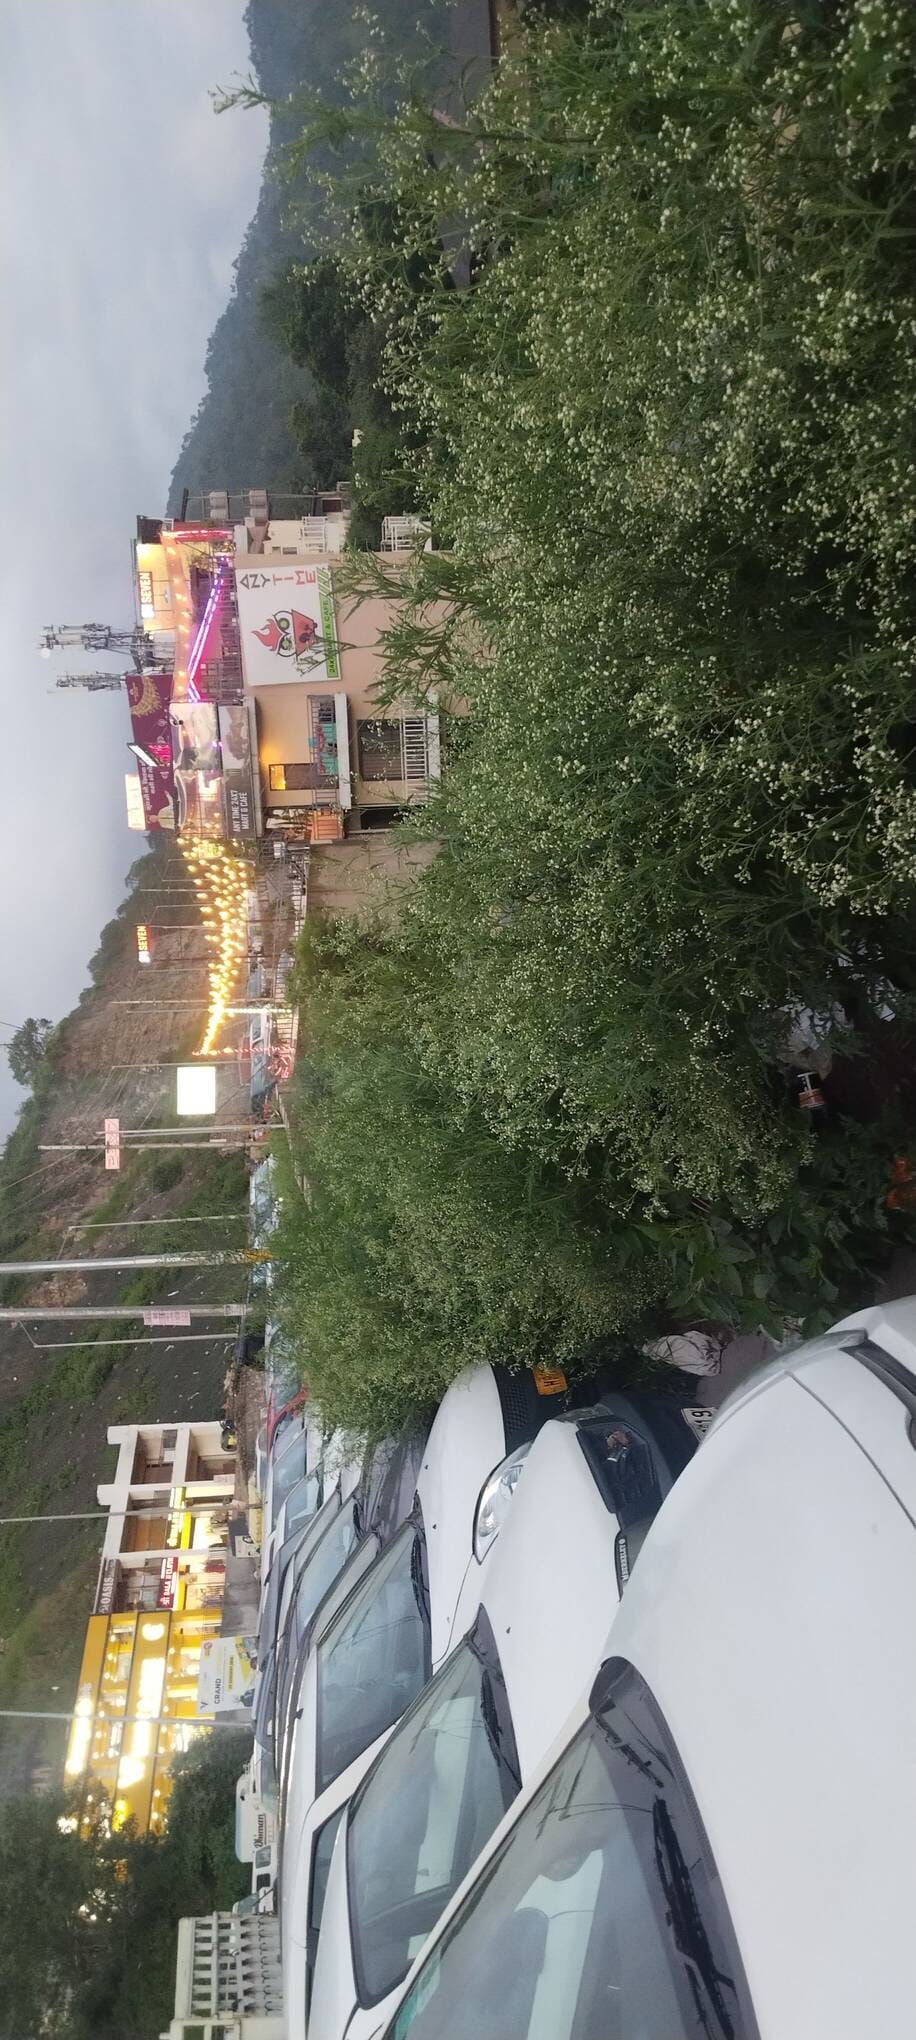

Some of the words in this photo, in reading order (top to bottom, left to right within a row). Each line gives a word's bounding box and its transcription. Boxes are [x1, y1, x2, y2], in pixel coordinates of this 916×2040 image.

[139, 572, 152, 603] SEVEN
[240, 574, 270, 590] ANY
[272, 570, 316, 586] TIME
[231, 806, 240, 819] TIME
[240, 814, 249, 829] MART
[232, 820, 240, 832] ANY
[136, 926, 148, 950] SEVEN
[100, 1577, 114, 1604] OASIS
[214, 1678, 222, 1704] GRAND
